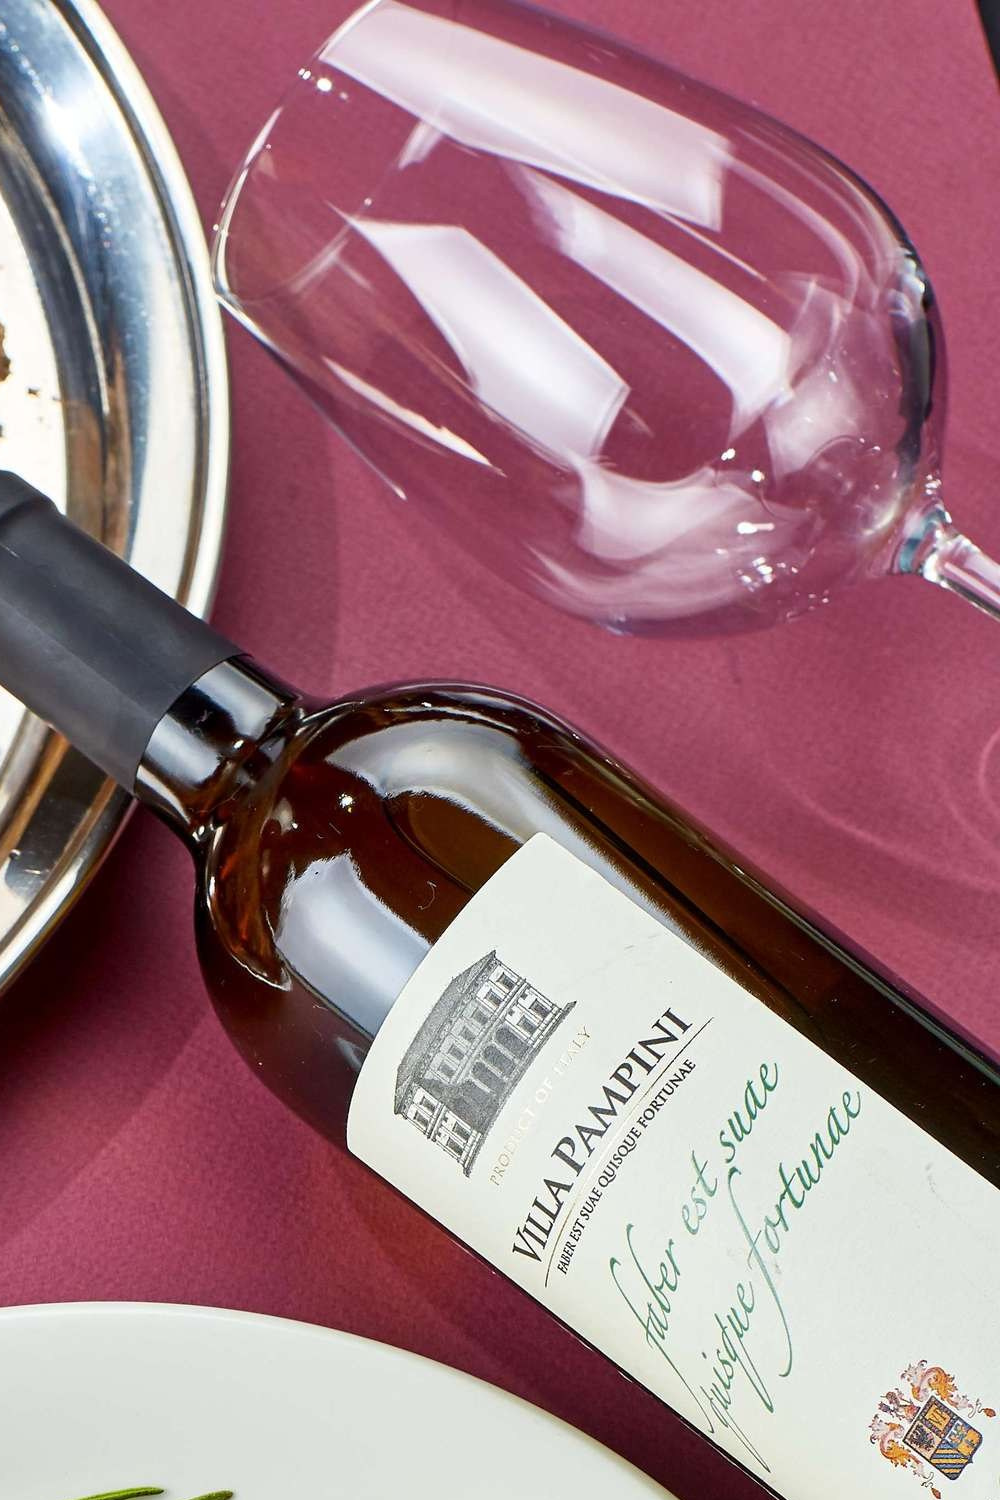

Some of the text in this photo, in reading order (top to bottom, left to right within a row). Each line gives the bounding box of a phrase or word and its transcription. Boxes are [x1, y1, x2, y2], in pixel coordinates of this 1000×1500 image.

[512, 1007, 693, 1263] VILLA PAMPINI
[557, 1059, 697, 1275] FABER EST SUAE QUISQUE FORTUNAE
[681, 1149, 717, 1235] est
[719, 1062, 779, 1164] suae
